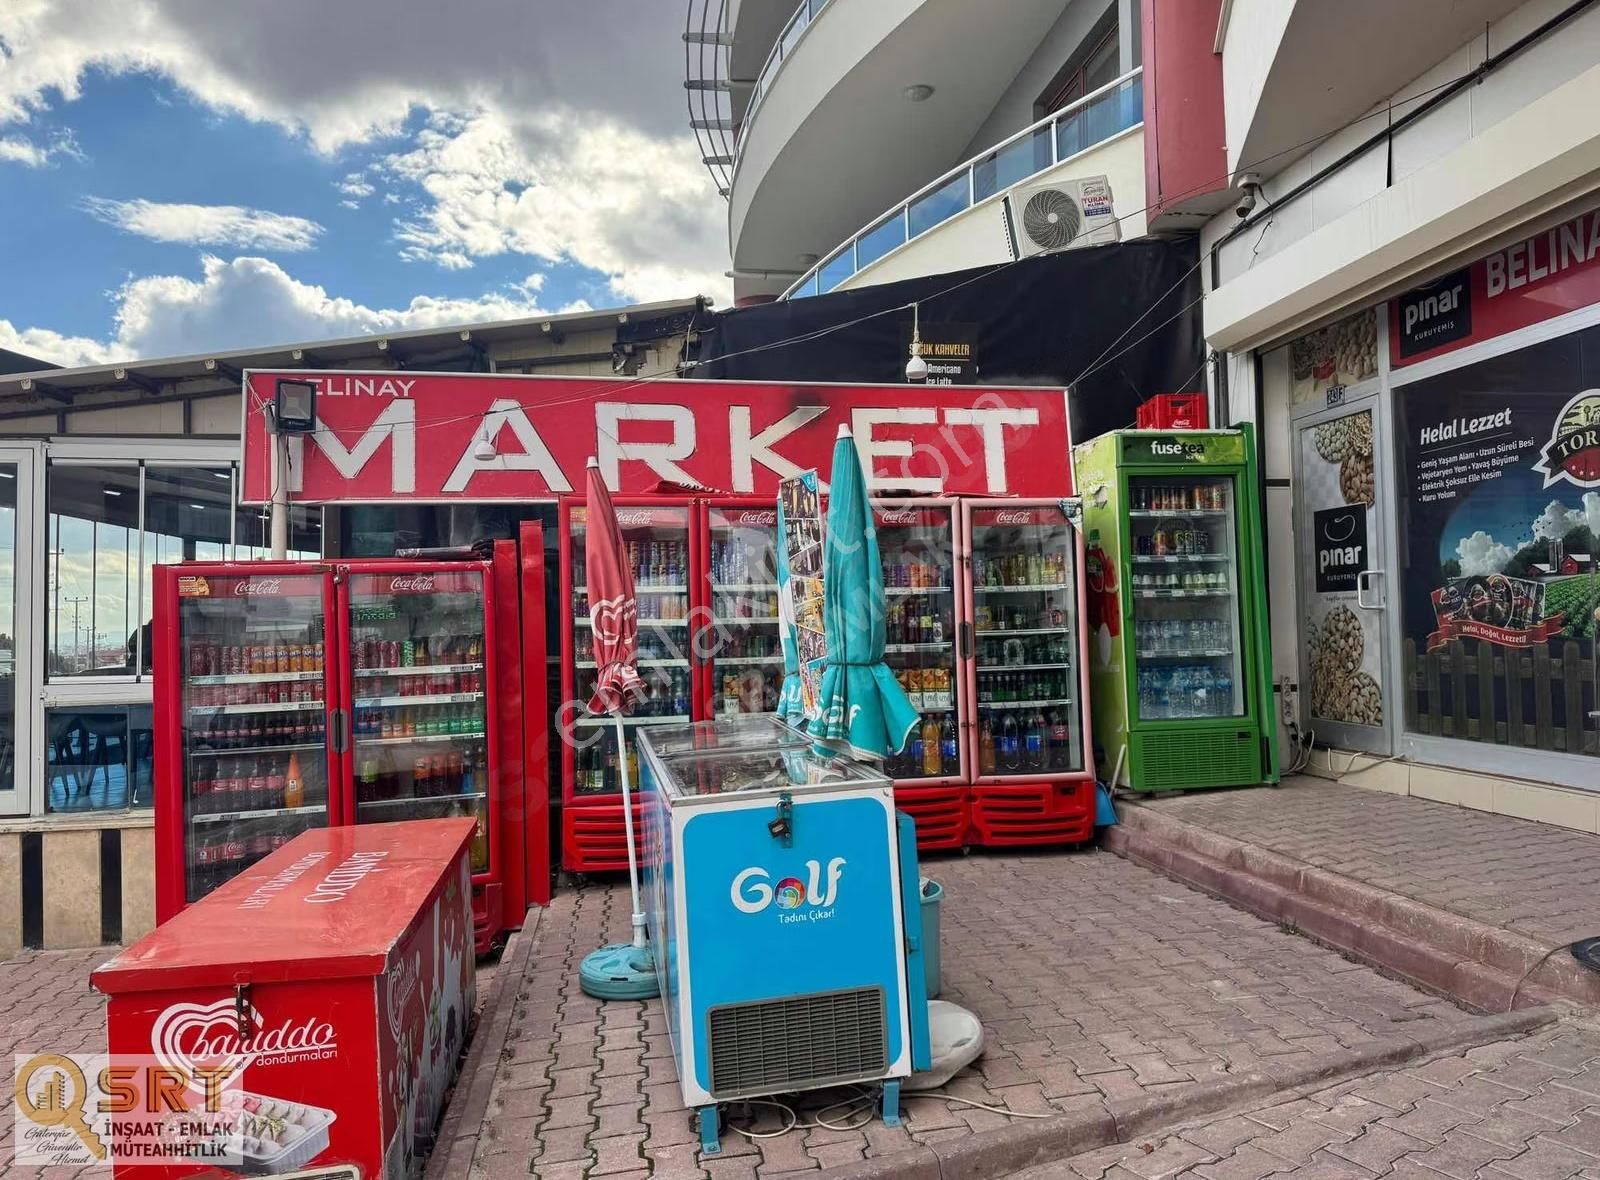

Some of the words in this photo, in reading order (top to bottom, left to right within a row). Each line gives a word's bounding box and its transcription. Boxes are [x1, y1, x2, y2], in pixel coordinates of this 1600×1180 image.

[935, 343, 970, 356] KAHVELER
[927, 363, 961, 374] Americano
[1420, 419, 1458, 446] Helal
[1460, 407, 1512, 436] Lezzet
[286, 397, 1040, 496] MARKET
